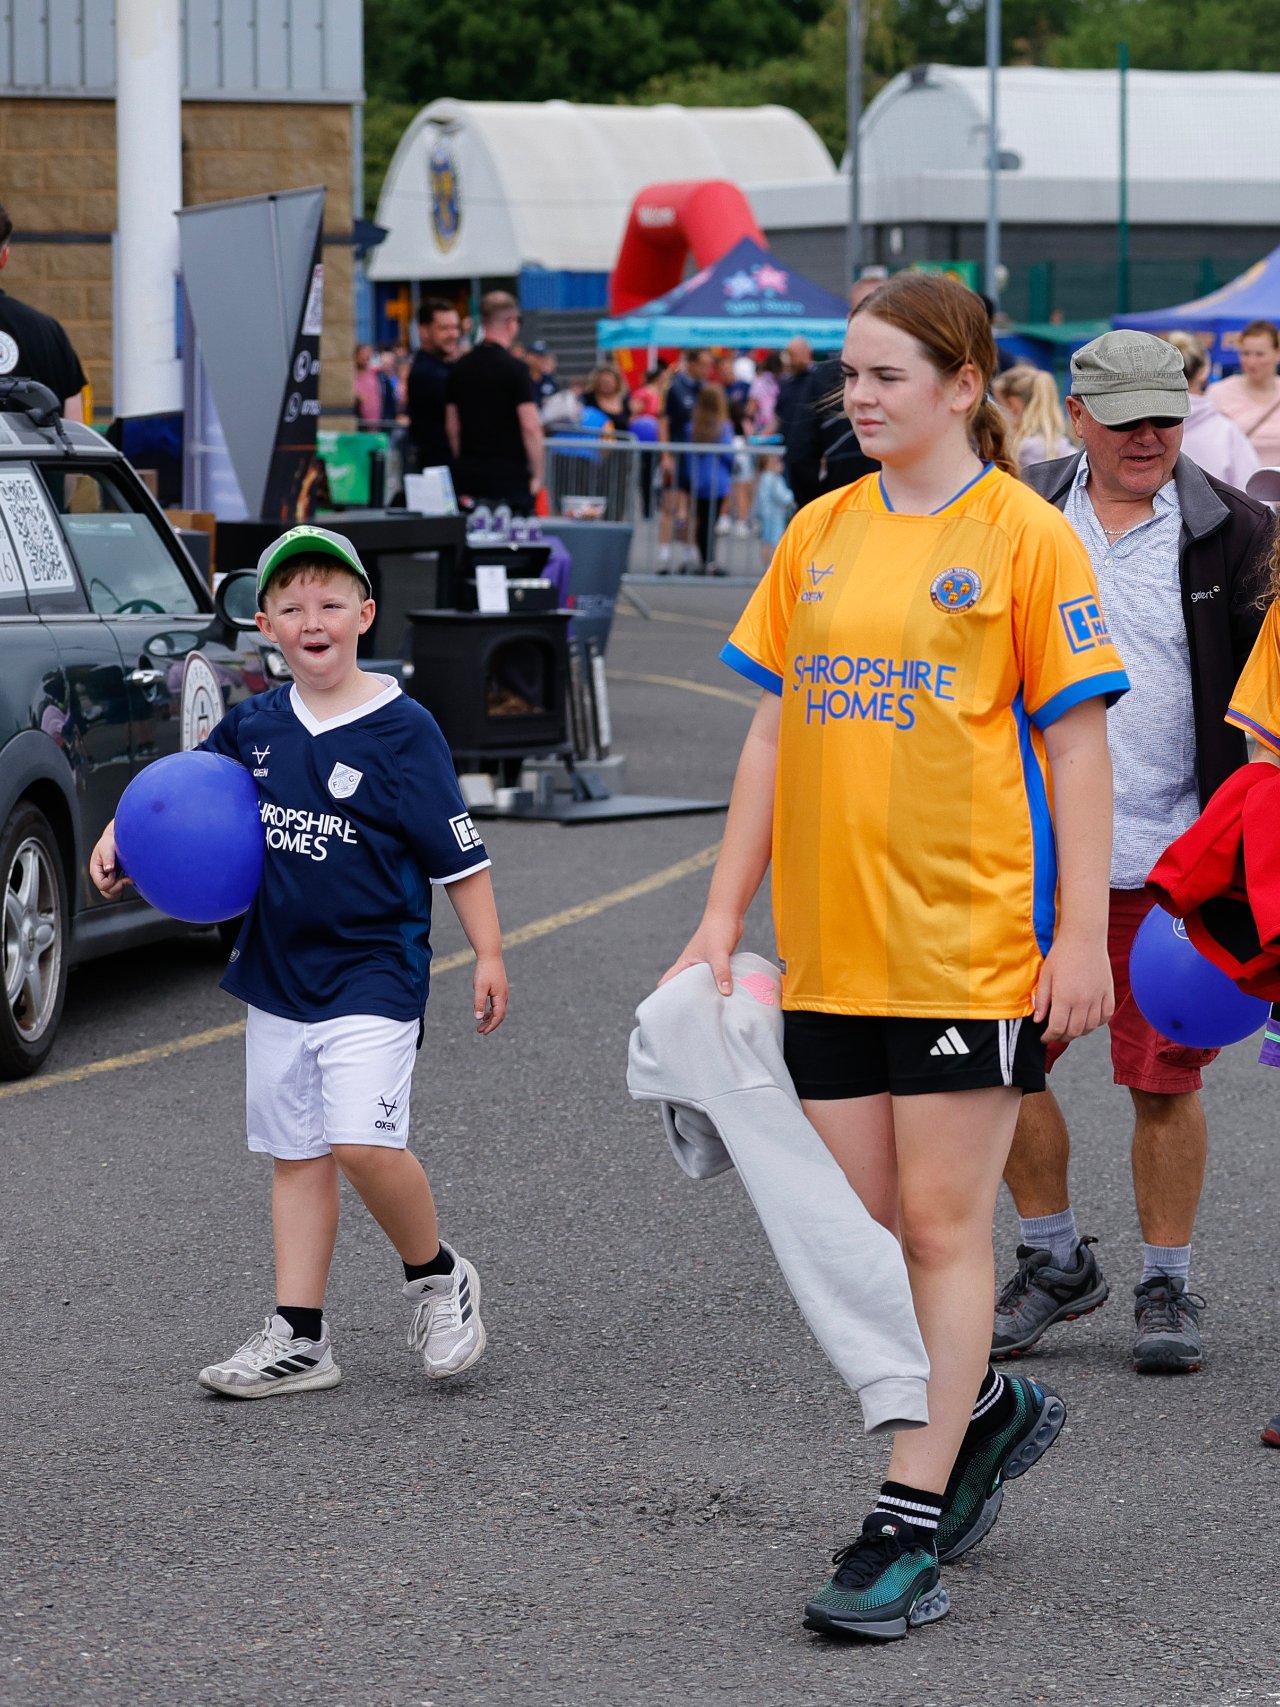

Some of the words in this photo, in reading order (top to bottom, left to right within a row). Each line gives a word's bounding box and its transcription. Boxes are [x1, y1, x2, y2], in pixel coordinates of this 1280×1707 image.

[793, 654, 957, 701] SHROPSHIRE
[805, 688, 916, 731] HOMES
[374, 1120, 397, 1132] OXEN
